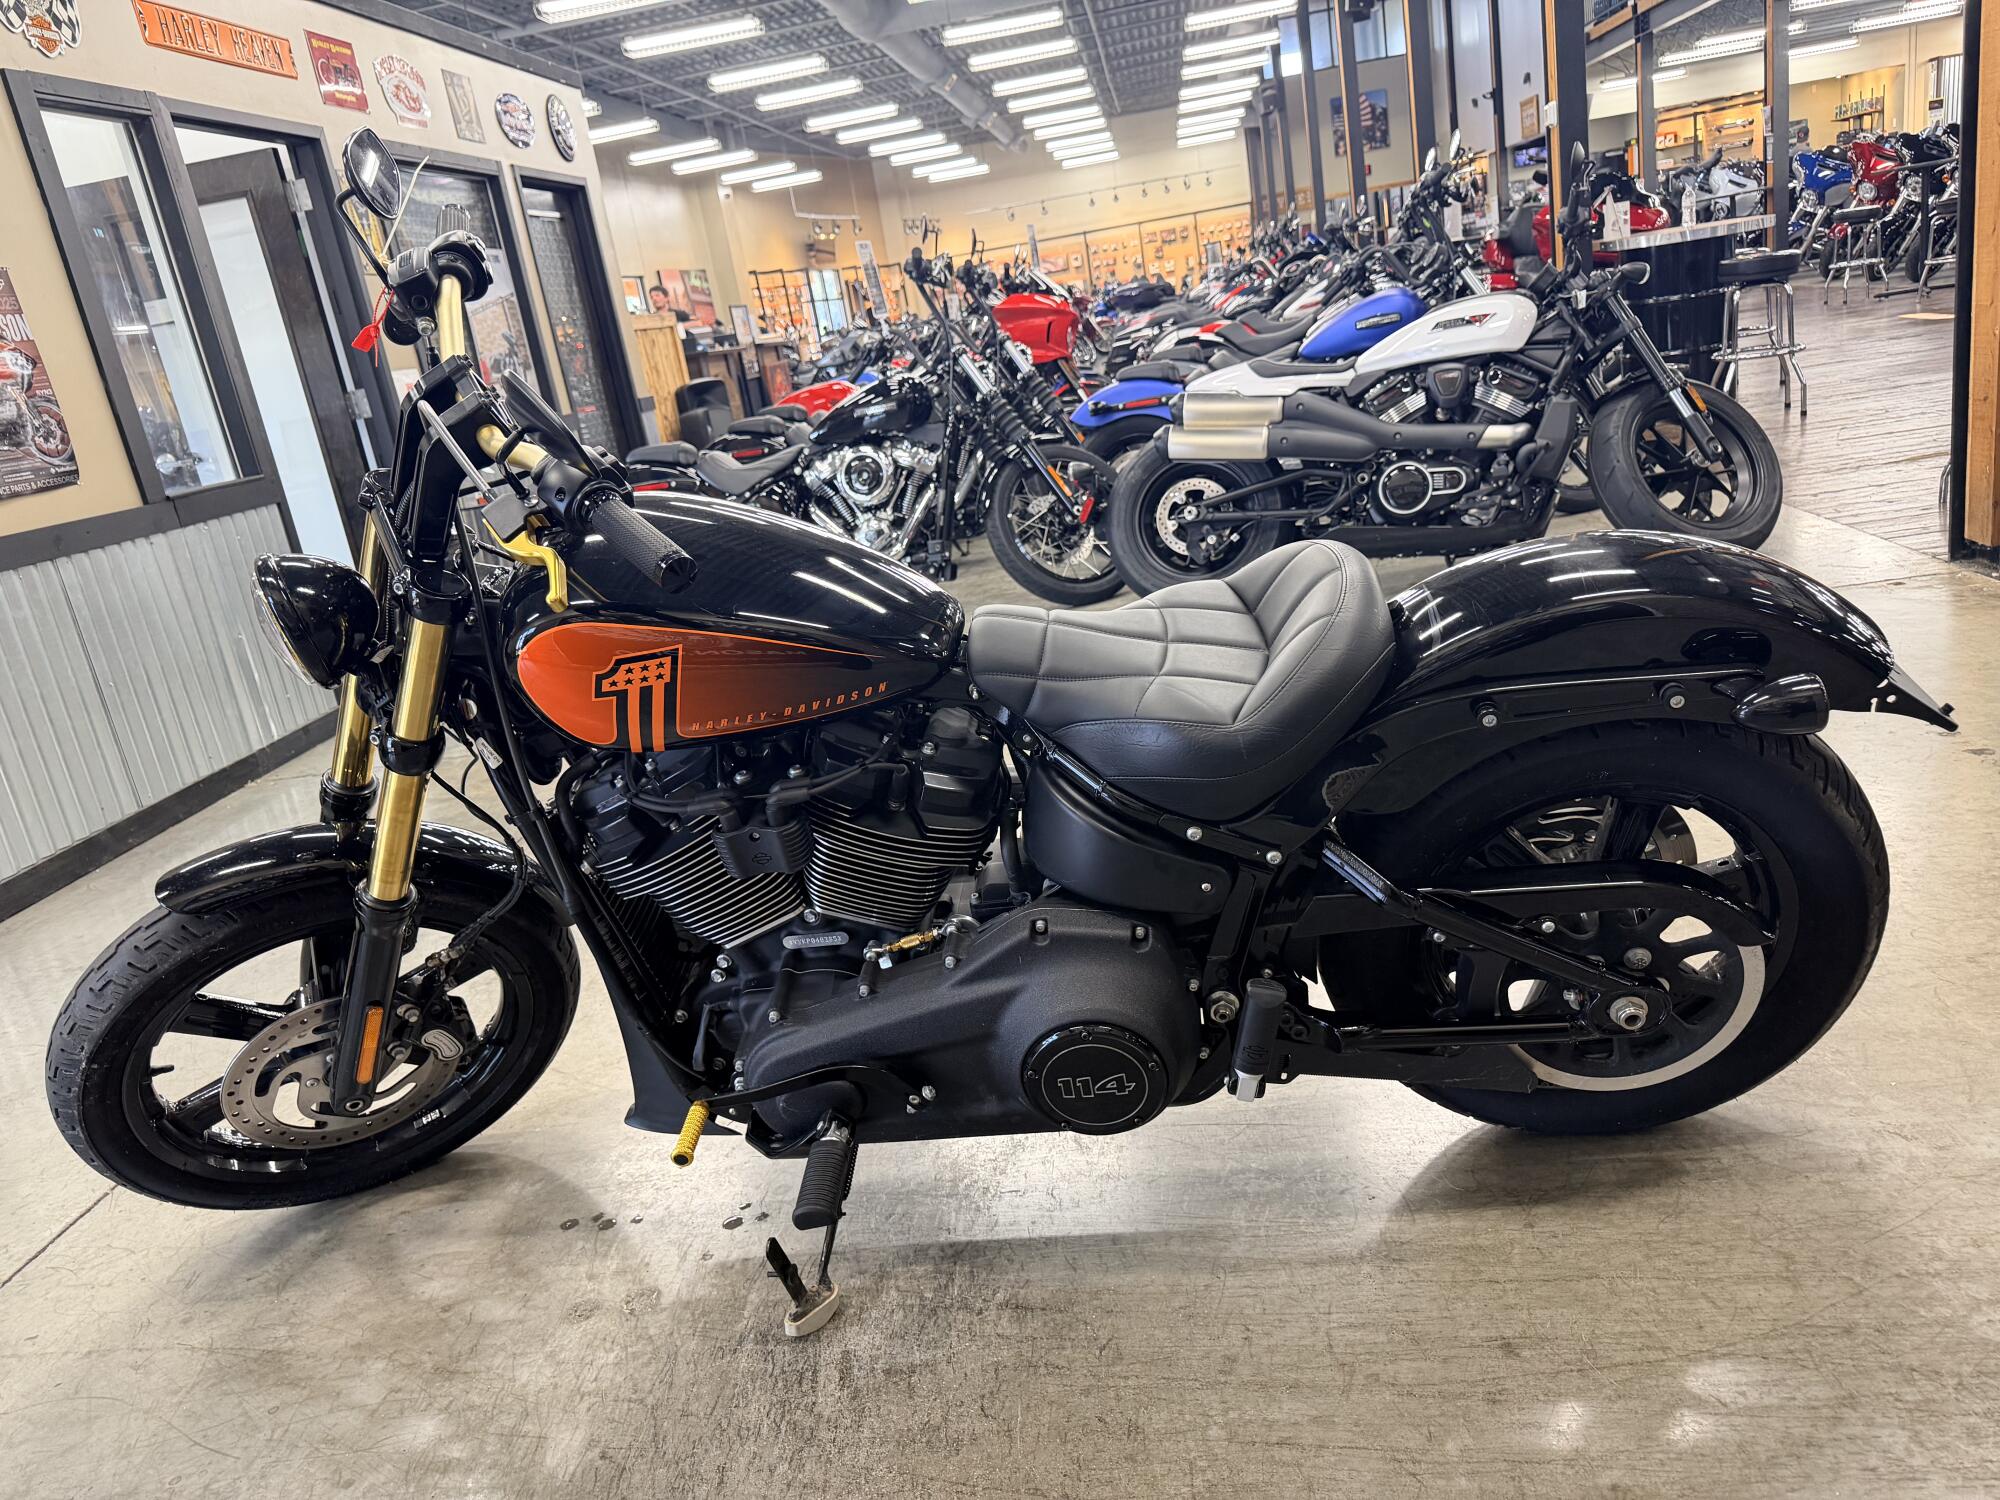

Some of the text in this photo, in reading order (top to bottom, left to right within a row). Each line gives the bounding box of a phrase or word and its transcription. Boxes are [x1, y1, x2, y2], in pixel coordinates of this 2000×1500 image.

[155, 7, 285, 71] HARLEY HEAVEN
[11, 482, 31, 494] PARTS
[692, 681, 888, 731] HARLEY-DAVIDSON
[1058, 1073, 1136, 1099] 114
